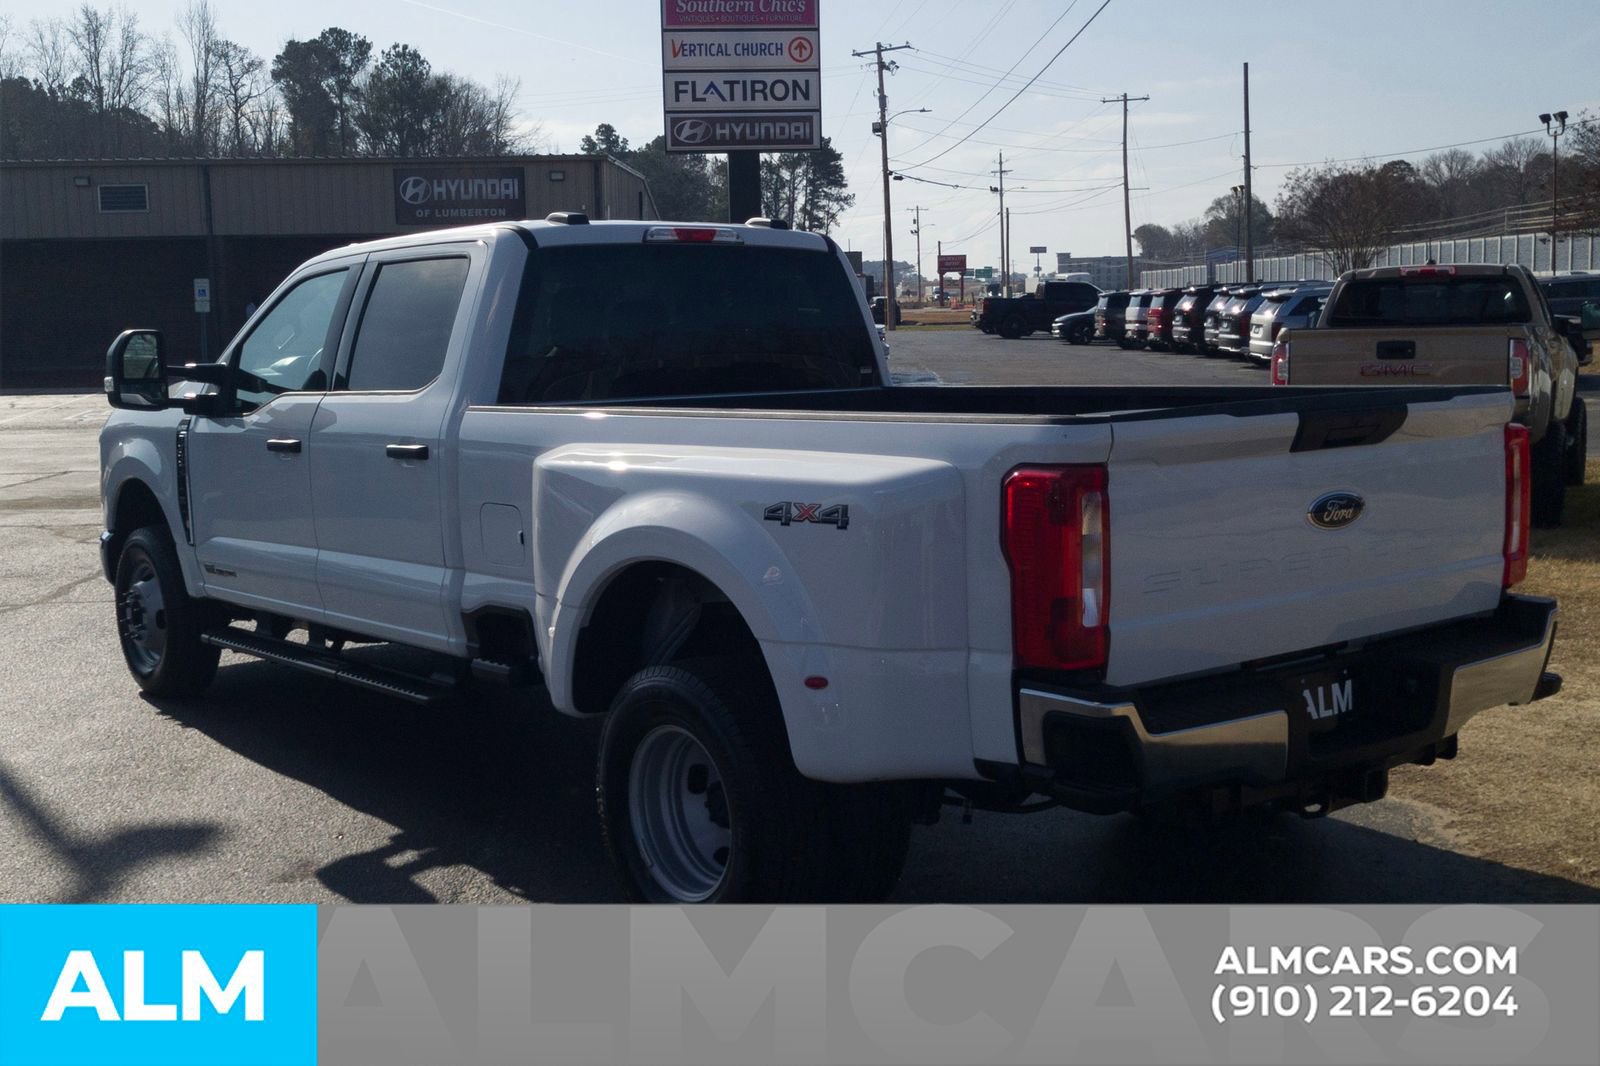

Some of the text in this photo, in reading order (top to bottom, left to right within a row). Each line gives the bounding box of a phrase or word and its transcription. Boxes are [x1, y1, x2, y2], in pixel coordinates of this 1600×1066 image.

[676, 0, 806, 13] Southern Chic's
[671, 39, 783, 58] VERTICAL CHURCH
[674, 79, 810, 102] FLATIRON
[715, 122, 810, 141] HYUNDAI
[433, 178, 519, 200] HYUNDAI
[416, 208, 506, 218] OF LUMBERTON
[1323, 500, 1354, 522] Ford
